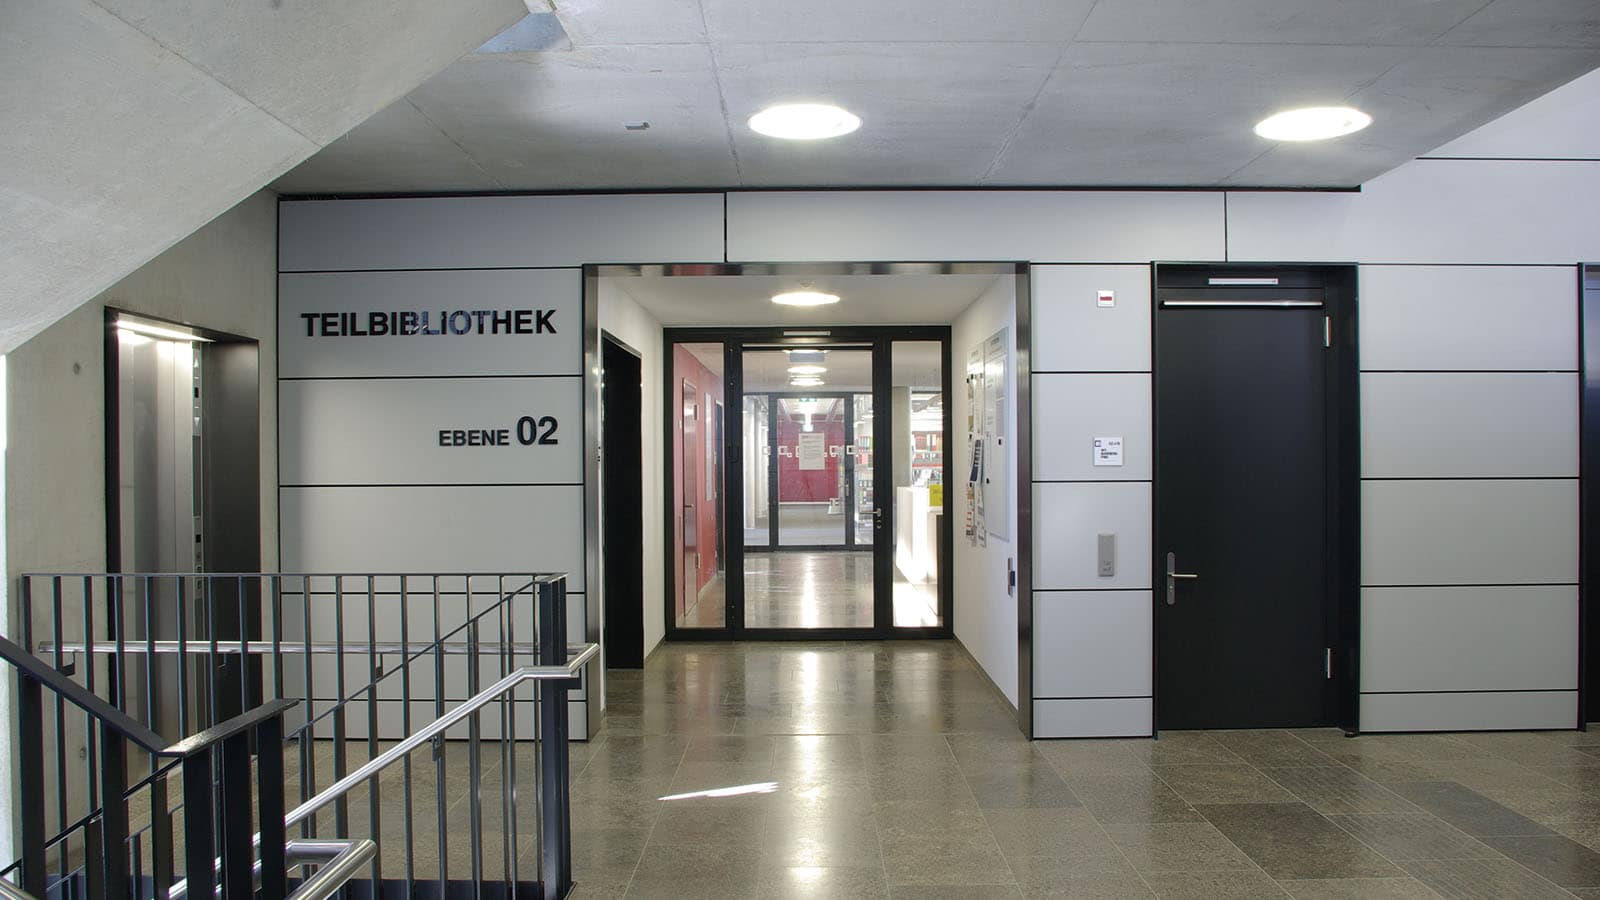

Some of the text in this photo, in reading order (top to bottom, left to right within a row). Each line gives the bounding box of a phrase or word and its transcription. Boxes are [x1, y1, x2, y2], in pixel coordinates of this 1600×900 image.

[300, 310, 557, 337] TEILBIBLIOTHEK
[439, 416, 559, 446] EBENE 02
